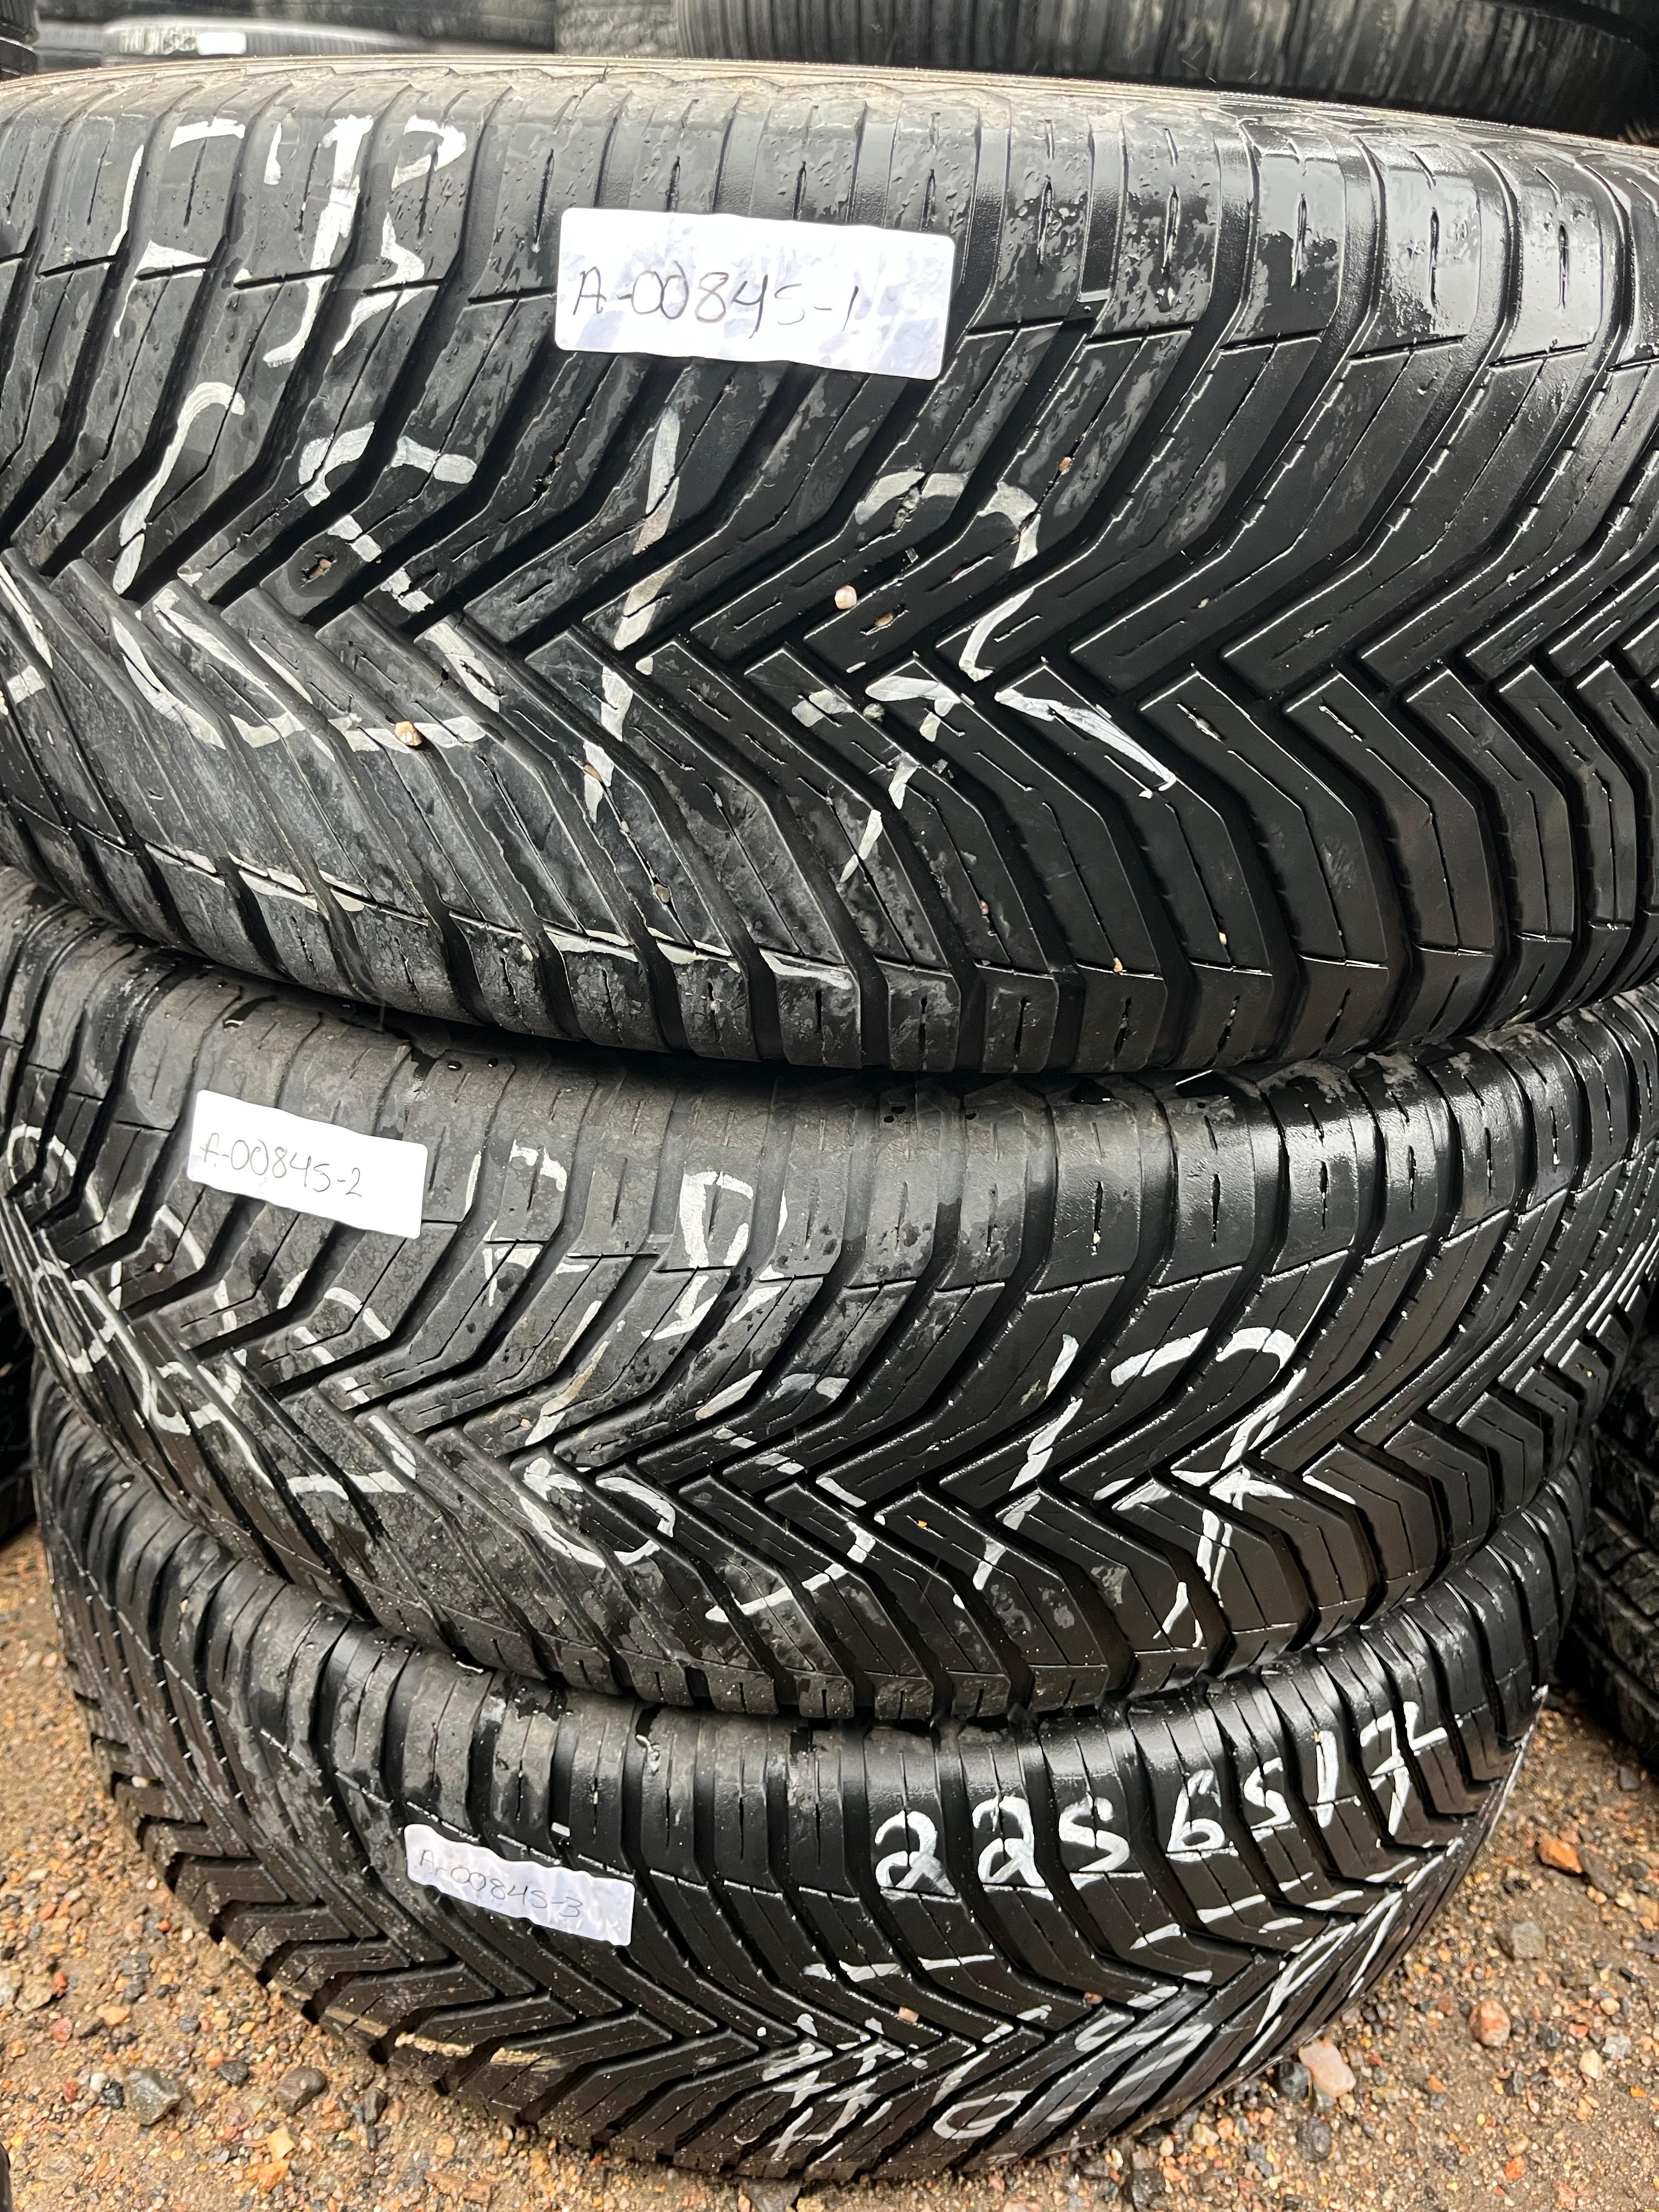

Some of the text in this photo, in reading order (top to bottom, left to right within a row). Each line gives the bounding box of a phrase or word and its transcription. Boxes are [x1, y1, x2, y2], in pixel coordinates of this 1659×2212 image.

[573, 260, 860, 338] A-00845-1
[199, 1132, 363, 1198] A-00845-2
[875, 1701, 1448, 1902] 225 65 17
[419, 1848, 583, 1918] A-00845-3
